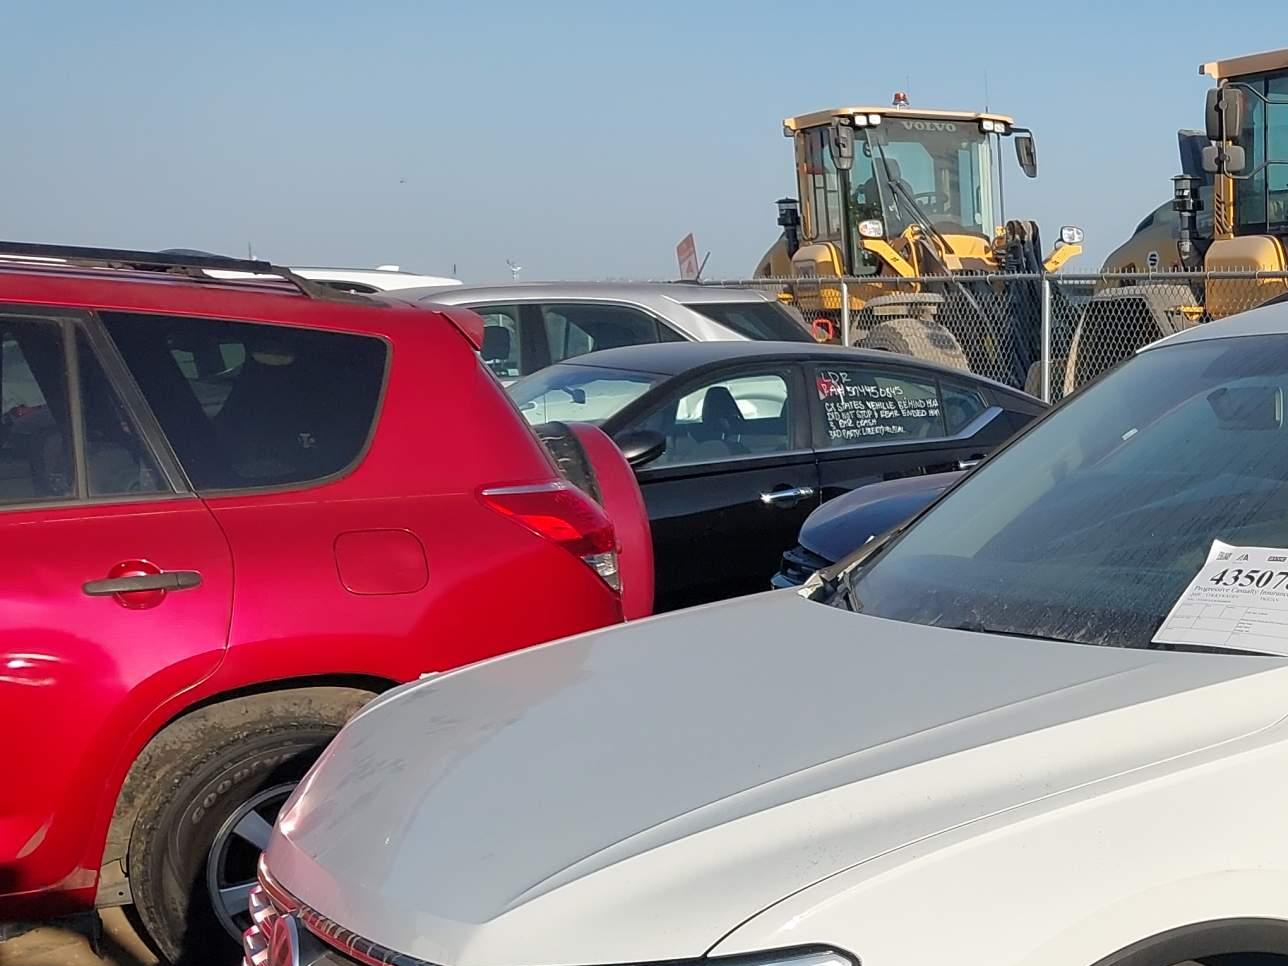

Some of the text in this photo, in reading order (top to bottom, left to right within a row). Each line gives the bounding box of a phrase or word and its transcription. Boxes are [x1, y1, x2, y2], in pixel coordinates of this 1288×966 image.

[902, 120, 957, 132] VOLVO
[821, 371, 852, 384] LDR
[1231, 587, 1258, 596] Casualty
